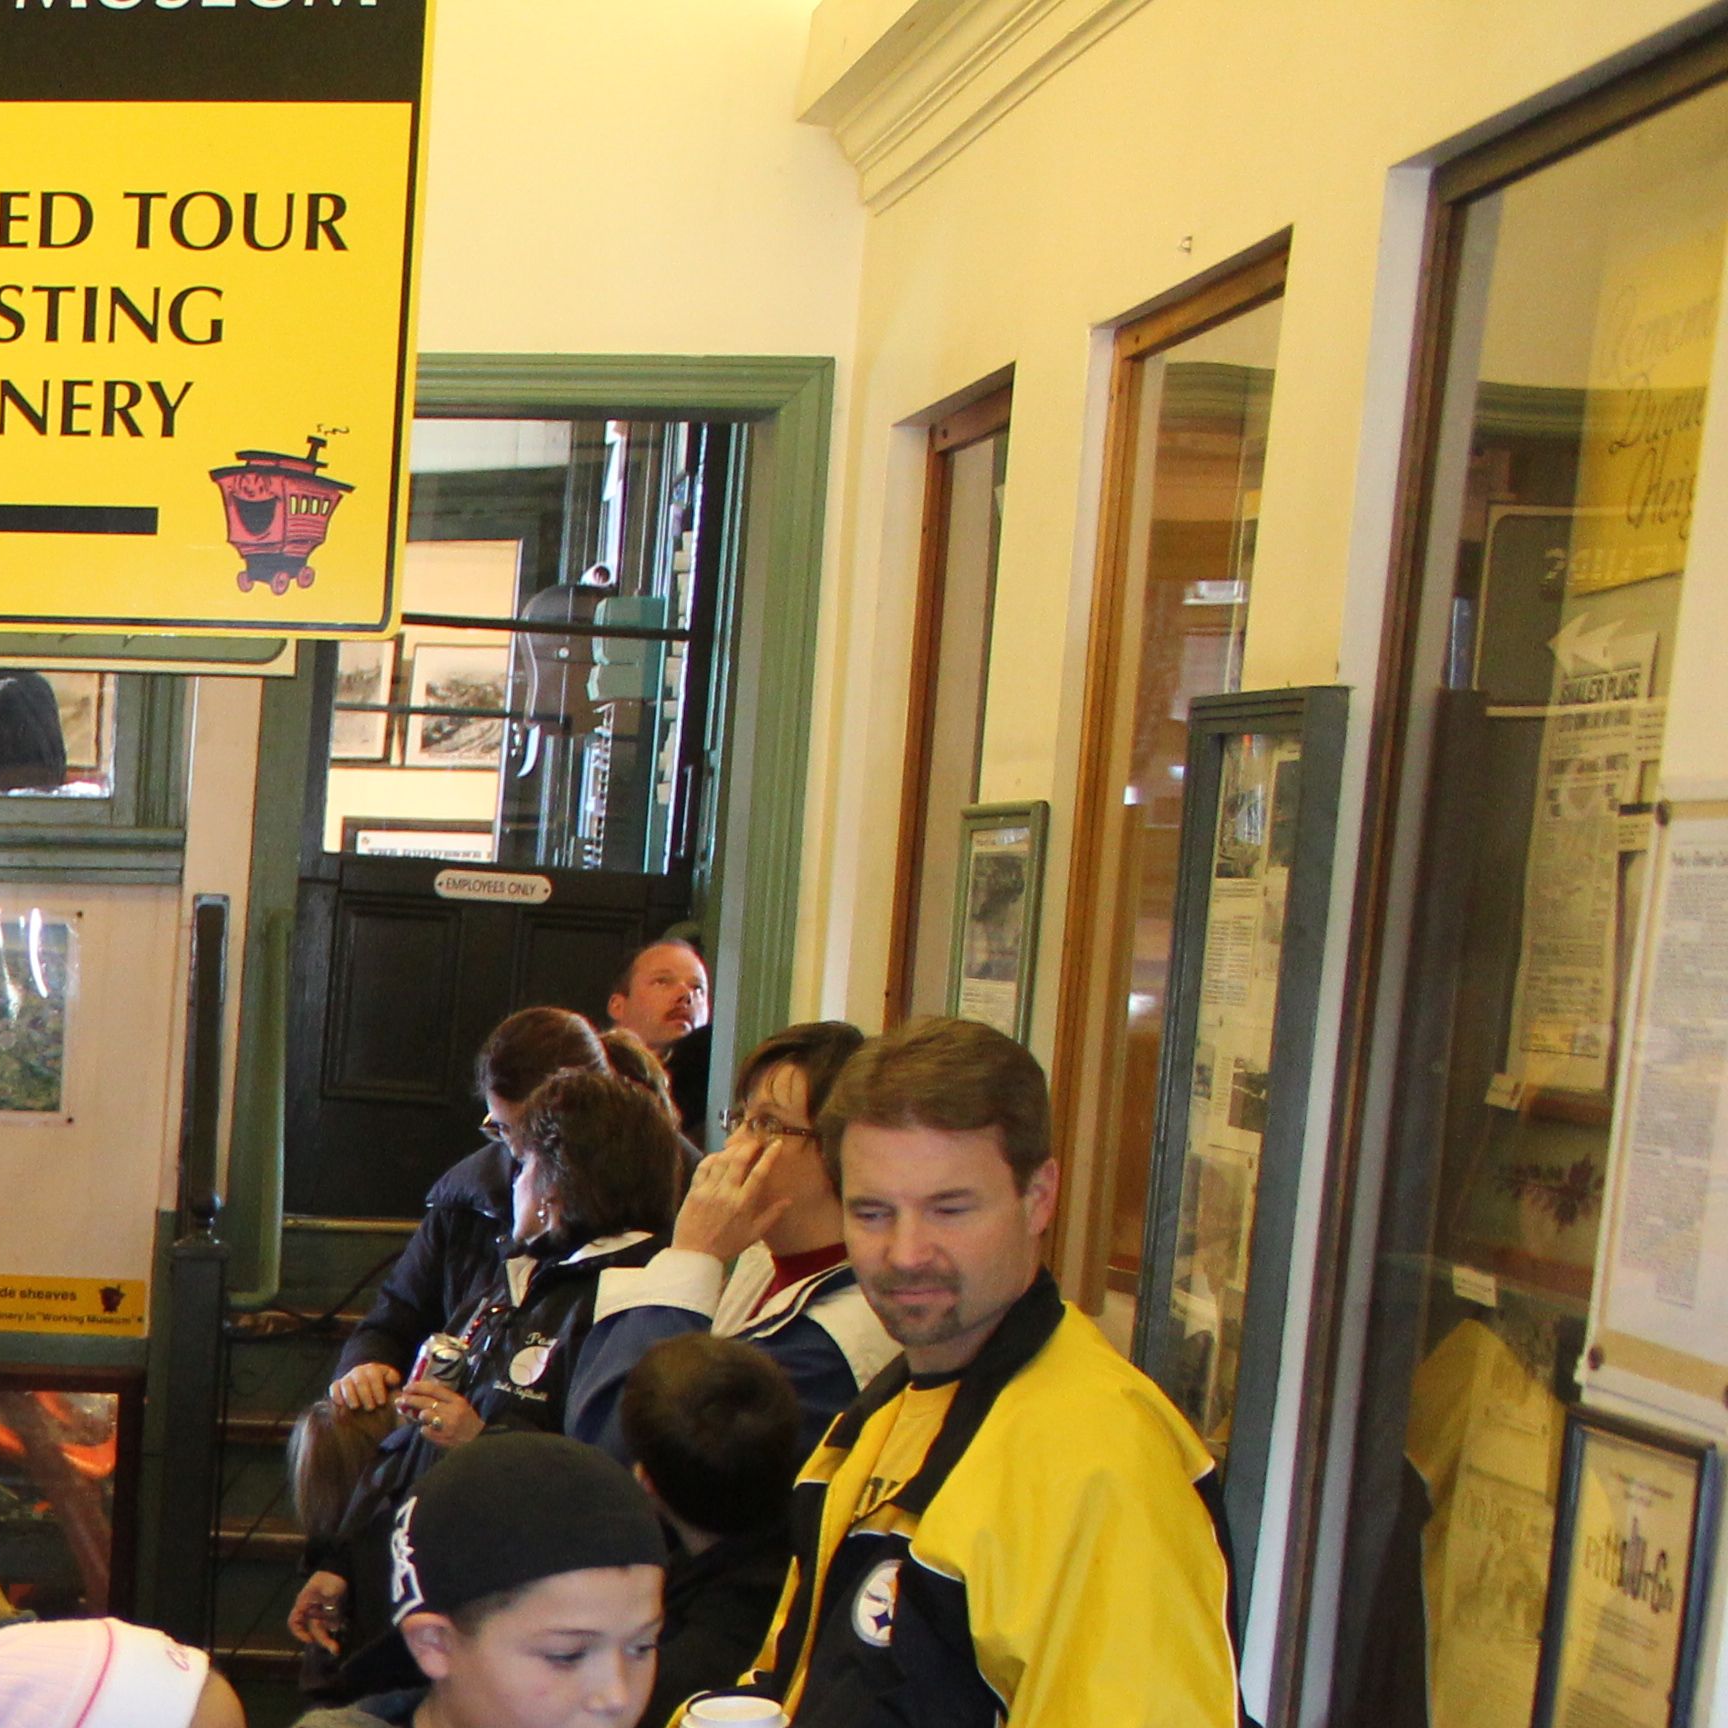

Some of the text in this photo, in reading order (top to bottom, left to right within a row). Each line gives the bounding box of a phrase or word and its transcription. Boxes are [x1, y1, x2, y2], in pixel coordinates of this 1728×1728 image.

[123, 191, 349, 253] TOUR
[446, 877, 537, 896] EMPLOYEES ONLY
[19, 1288, 77, 1302] sheaves
